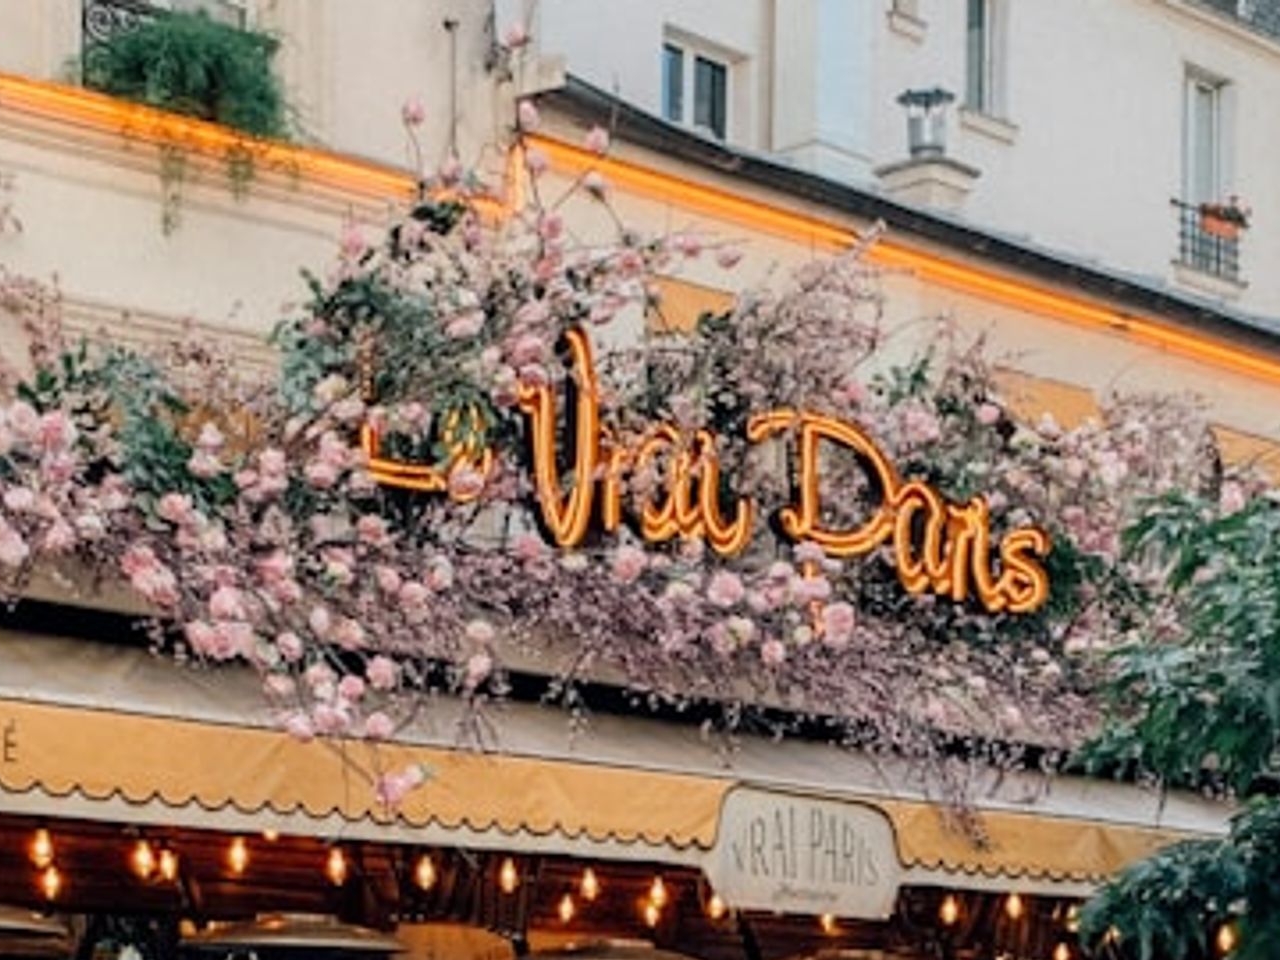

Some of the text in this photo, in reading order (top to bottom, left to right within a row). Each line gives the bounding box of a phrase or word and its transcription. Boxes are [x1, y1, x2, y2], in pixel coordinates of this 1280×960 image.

[516, 325, 754, 558] Vrai
[732, 805, 880, 887] VRAI PARIS
